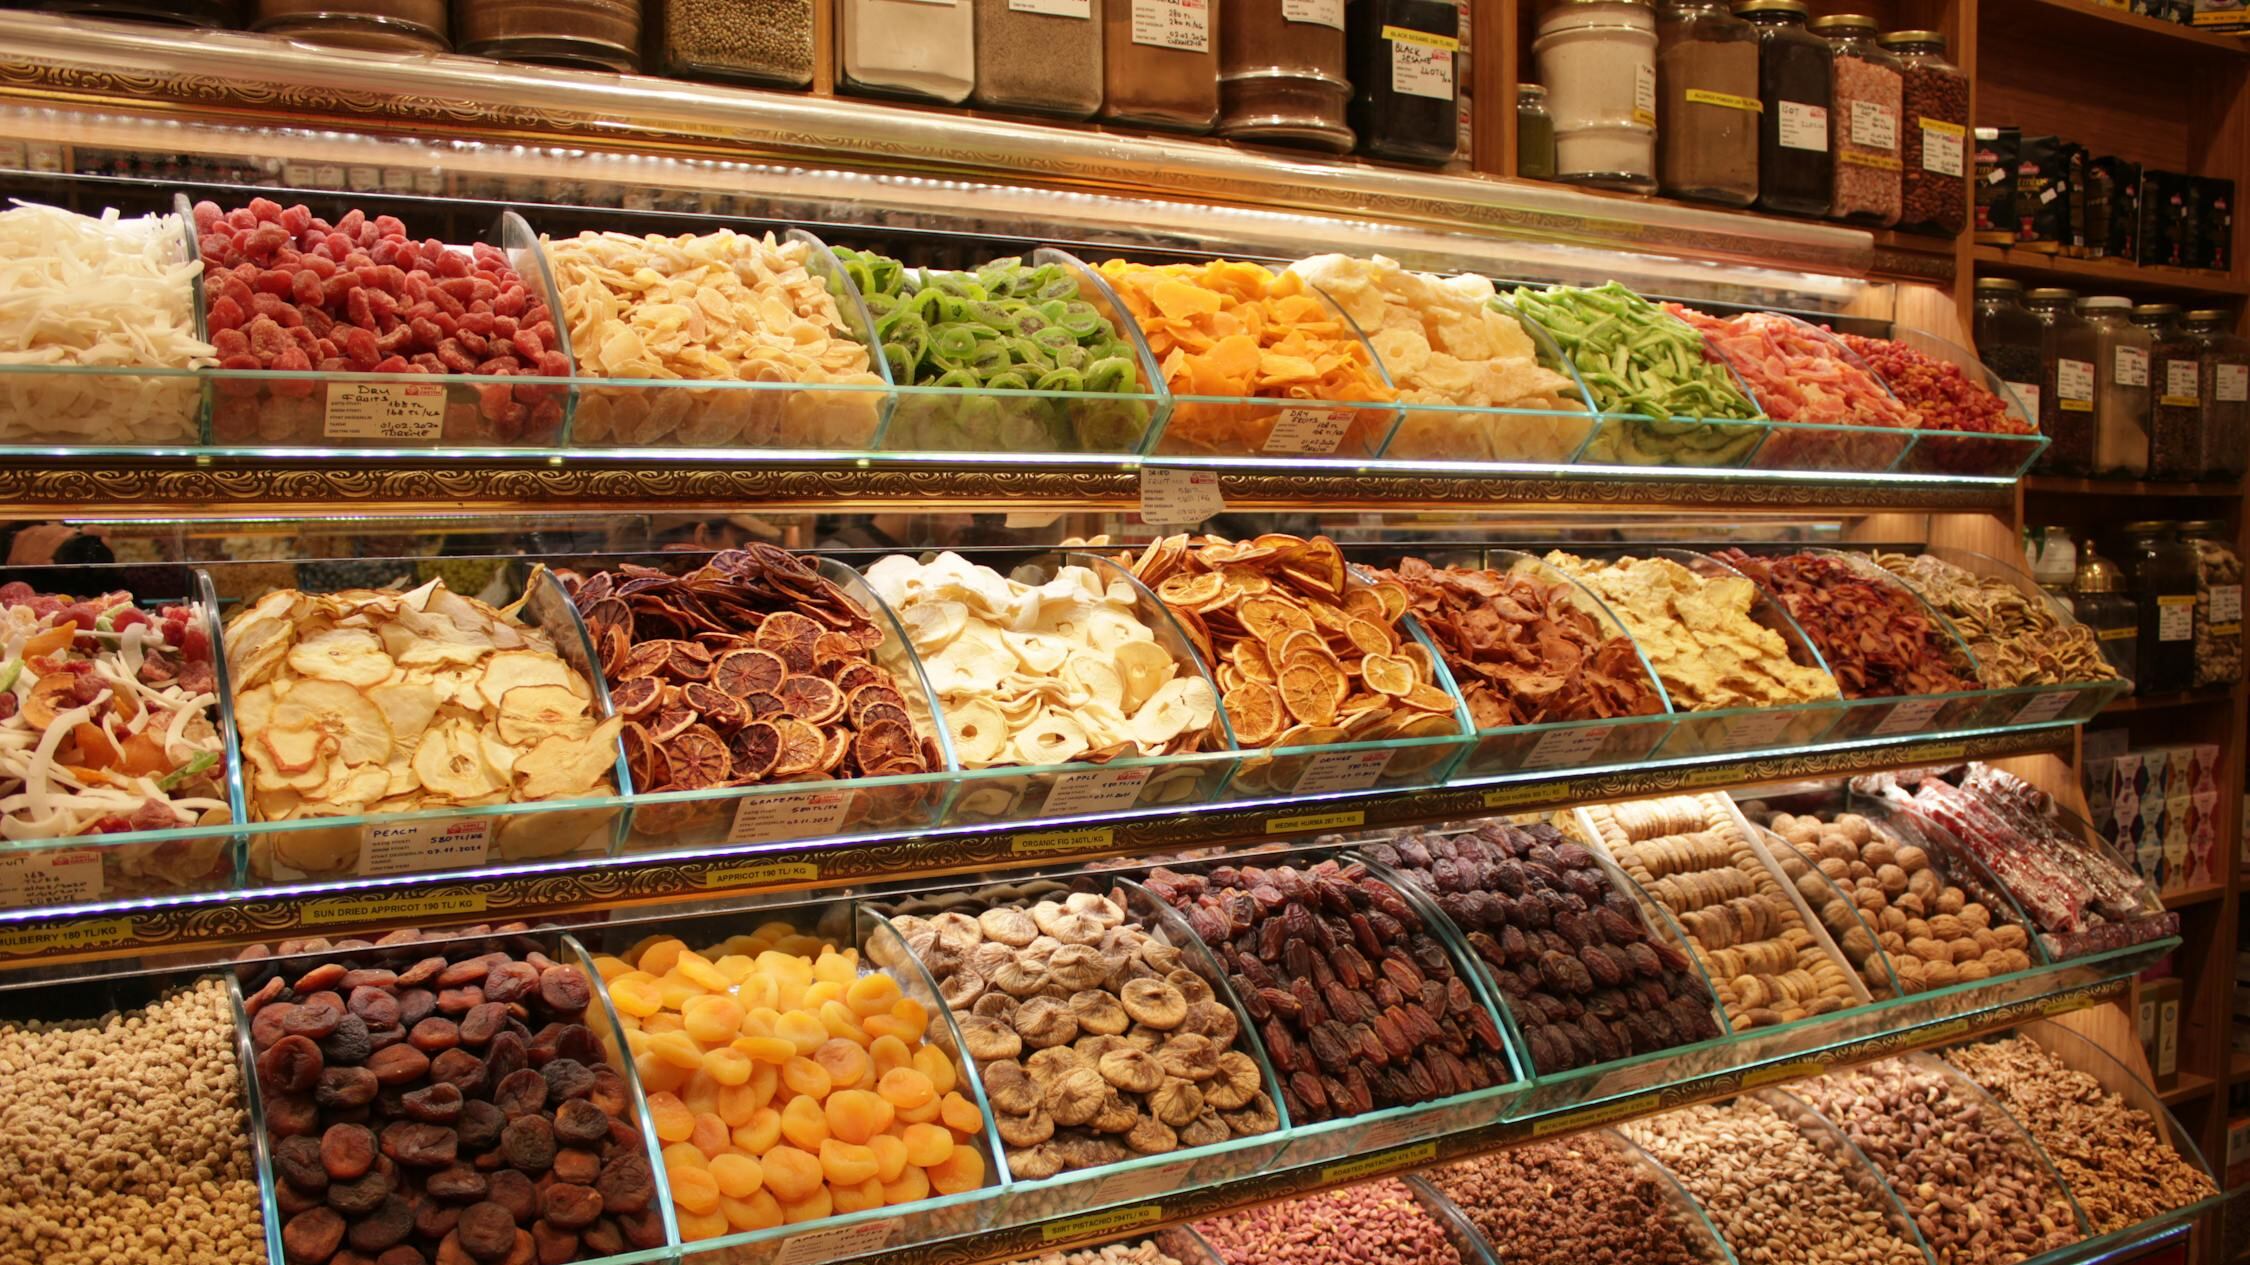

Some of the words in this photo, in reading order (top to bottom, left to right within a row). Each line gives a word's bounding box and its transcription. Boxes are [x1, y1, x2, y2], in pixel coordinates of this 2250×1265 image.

[1395, 42, 1420, 56] BLACK
[1066, 773, 1099, 782] APPLE
[373, 828, 418, 838] PEACH
[1022, 839, 1056, 848] ORGANIC
[1057, 838, 1070, 846] FIG
[0, 858, 25, 867] UIT
[716, 872, 759, 882] APPRICOT
[313, 910, 336, 918] SUN
[337, 907, 368, 917] DRIED
[370, 904, 420, 914] APPRICOT
[423, 902, 439, 910] 190
[458, 900, 473, 908] KG
[64, 932, 80, 940] 180
[83, 926, 118, 938] TL/KG
[1333, 1165, 1364, 1177] ROASTED
[1364, 1156, 1398, 1170] PISTACHIO
[1052, 1224, 1072, 1234] SIIRT
[1072, 1216, 1112, 1230] PISTACHIO
